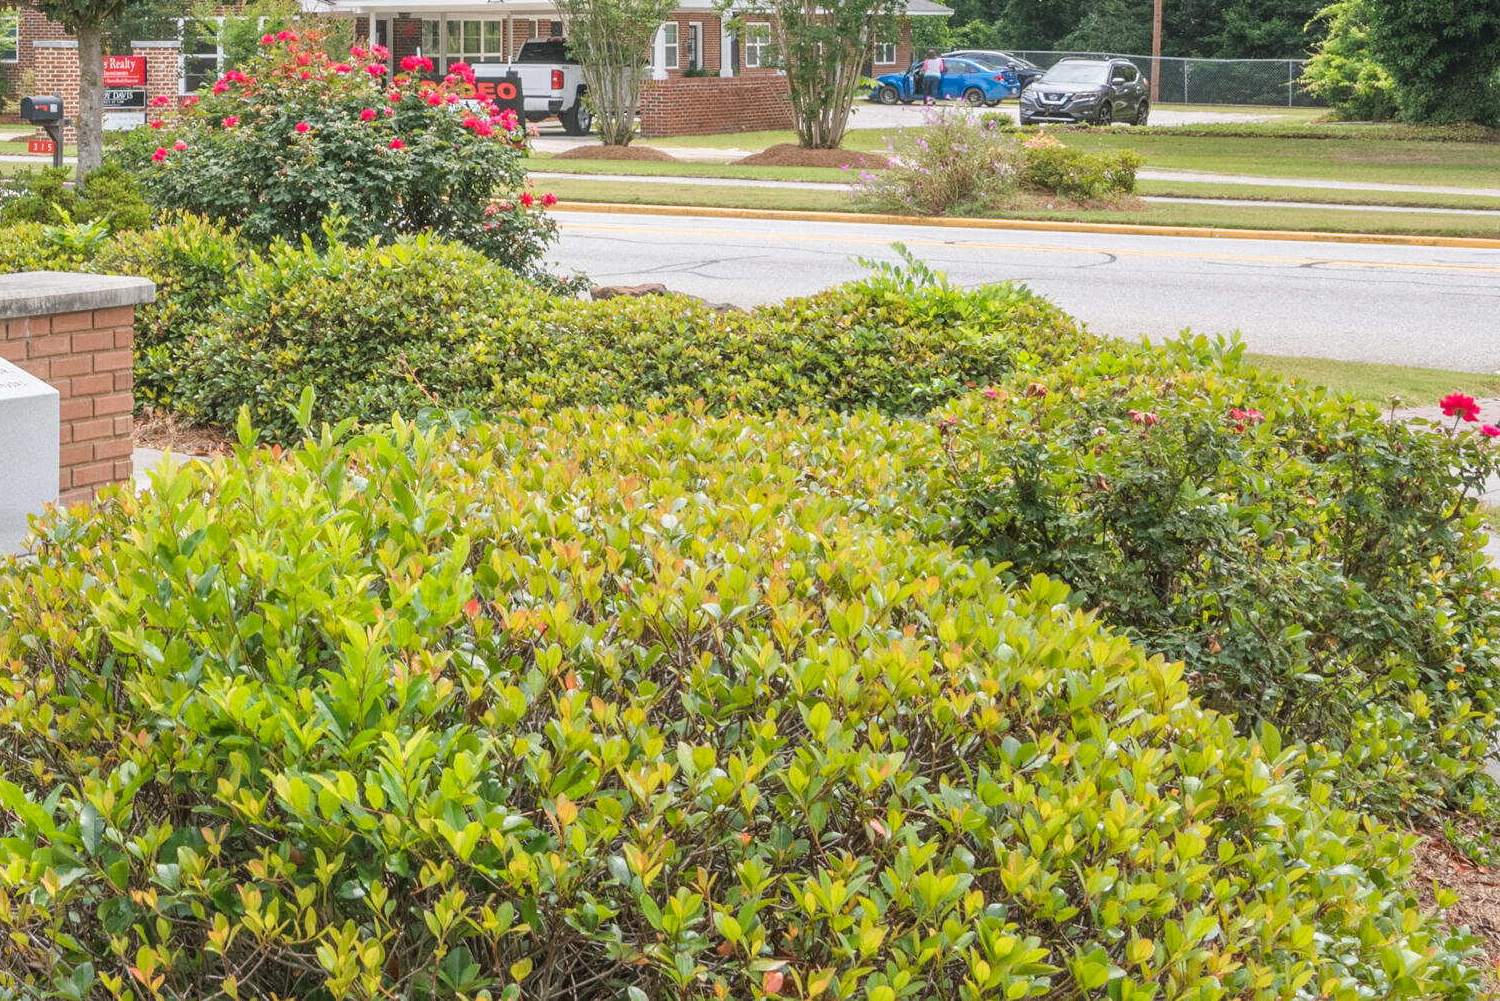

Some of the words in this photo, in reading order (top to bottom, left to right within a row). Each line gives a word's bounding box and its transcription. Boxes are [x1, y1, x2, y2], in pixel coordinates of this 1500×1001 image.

[109, 57, 136, 73] Realty
[113, 91, 133, 100] DAVIS
[34, 142, 52, 152] 315
